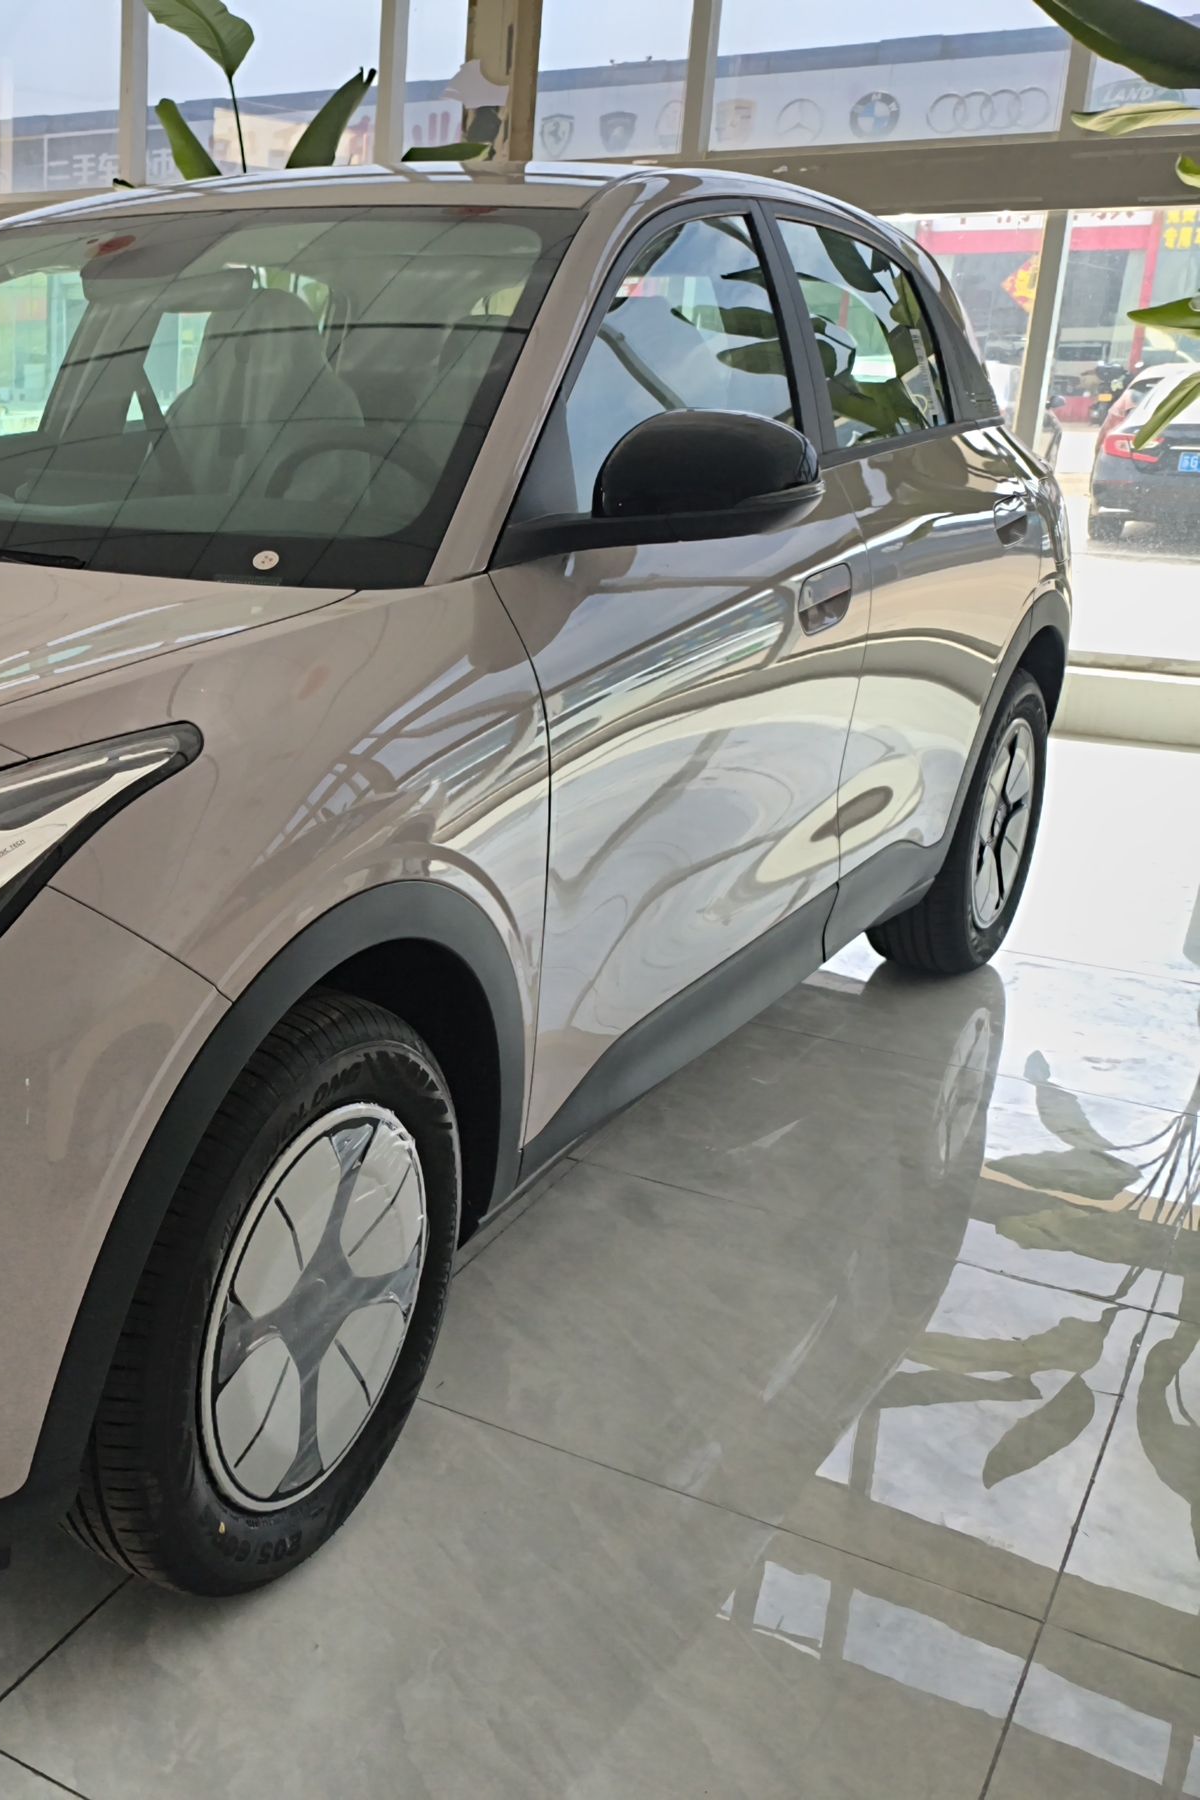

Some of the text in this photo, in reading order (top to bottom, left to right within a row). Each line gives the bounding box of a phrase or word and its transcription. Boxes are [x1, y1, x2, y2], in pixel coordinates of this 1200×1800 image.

[1103, 84, 1155, 103] LAND
[48, 148, 174, 184] 二手车市
